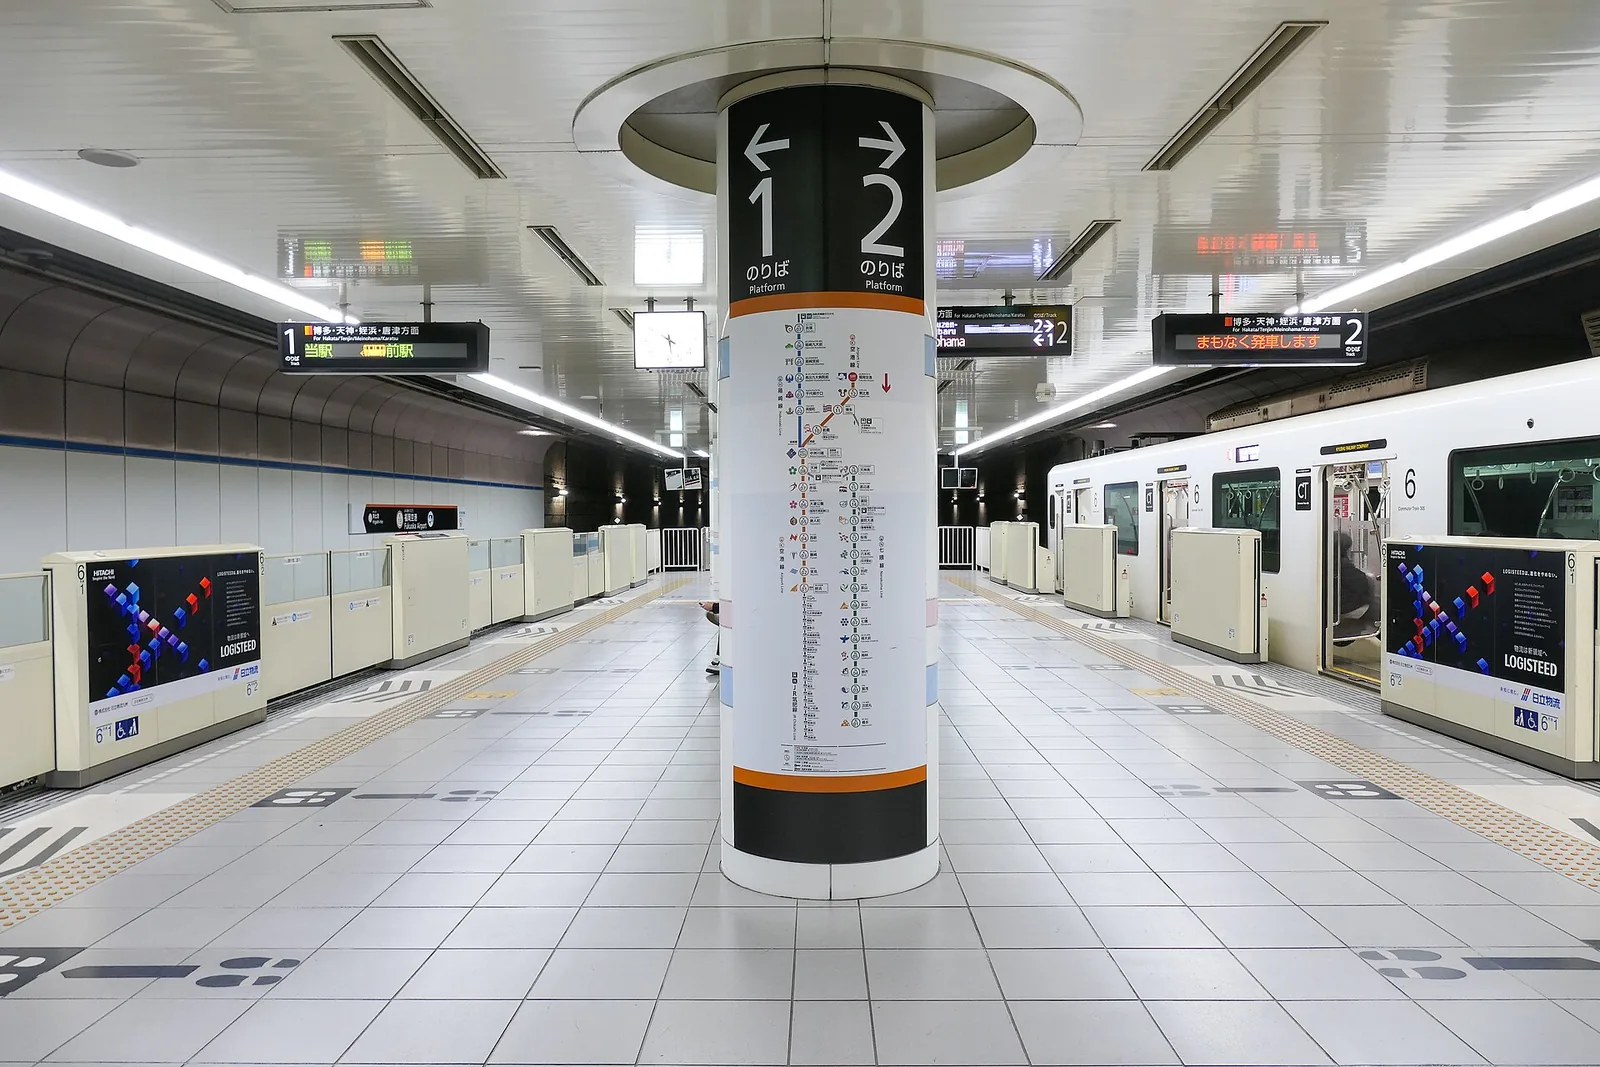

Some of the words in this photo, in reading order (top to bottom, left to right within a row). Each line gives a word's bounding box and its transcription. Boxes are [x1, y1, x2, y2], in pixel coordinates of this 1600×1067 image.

[749, 177, 773, 258] 1
[861, 174, 904, 258] 2
[746, 260, 790, 281] のりば
[860, 260, 905, 278] のりば
[750, 282, 786, 294] Platform
[865, 280, 902, 292] Platform
[1034, 319, 1043, 333] 2
[1056, 321, 1068, 344] 2
[1345, 318, 1362, 344] 2
[284, 328, 295, 354] 1
[1047, 333, 1054, 346] 1
[1196, 334, 1320, 350] まもなく発車します
[304, 344, 334, 358] 当駅
[386, 344, 414, 358] 前駅
[1298, 482, 1309, 500] CT
[1405, 468, 1416, 499] 6
[1194, 484, 1200, 504] 6
[1568, 552, 1575, 568] 6
[78, 564, 84, 580] 6
[1570, 573, 1574, 584] 1
[80, 584, 84, 595] 1
[220, 640, 257, 658] LOGISTEED
[1504, 654, 1558, 677] LOGISTEED
[1390, 674, 1395, 686] 6
[247, 683, 252, 696] 6
[1532, 692, 1561, 710] 日立物流
[1541, 716, 1548, 731] 6
[1554, 720, 1558, 731] 1
[96, 728, 103, 744] 6
[107, 726, 111, 737] 1
